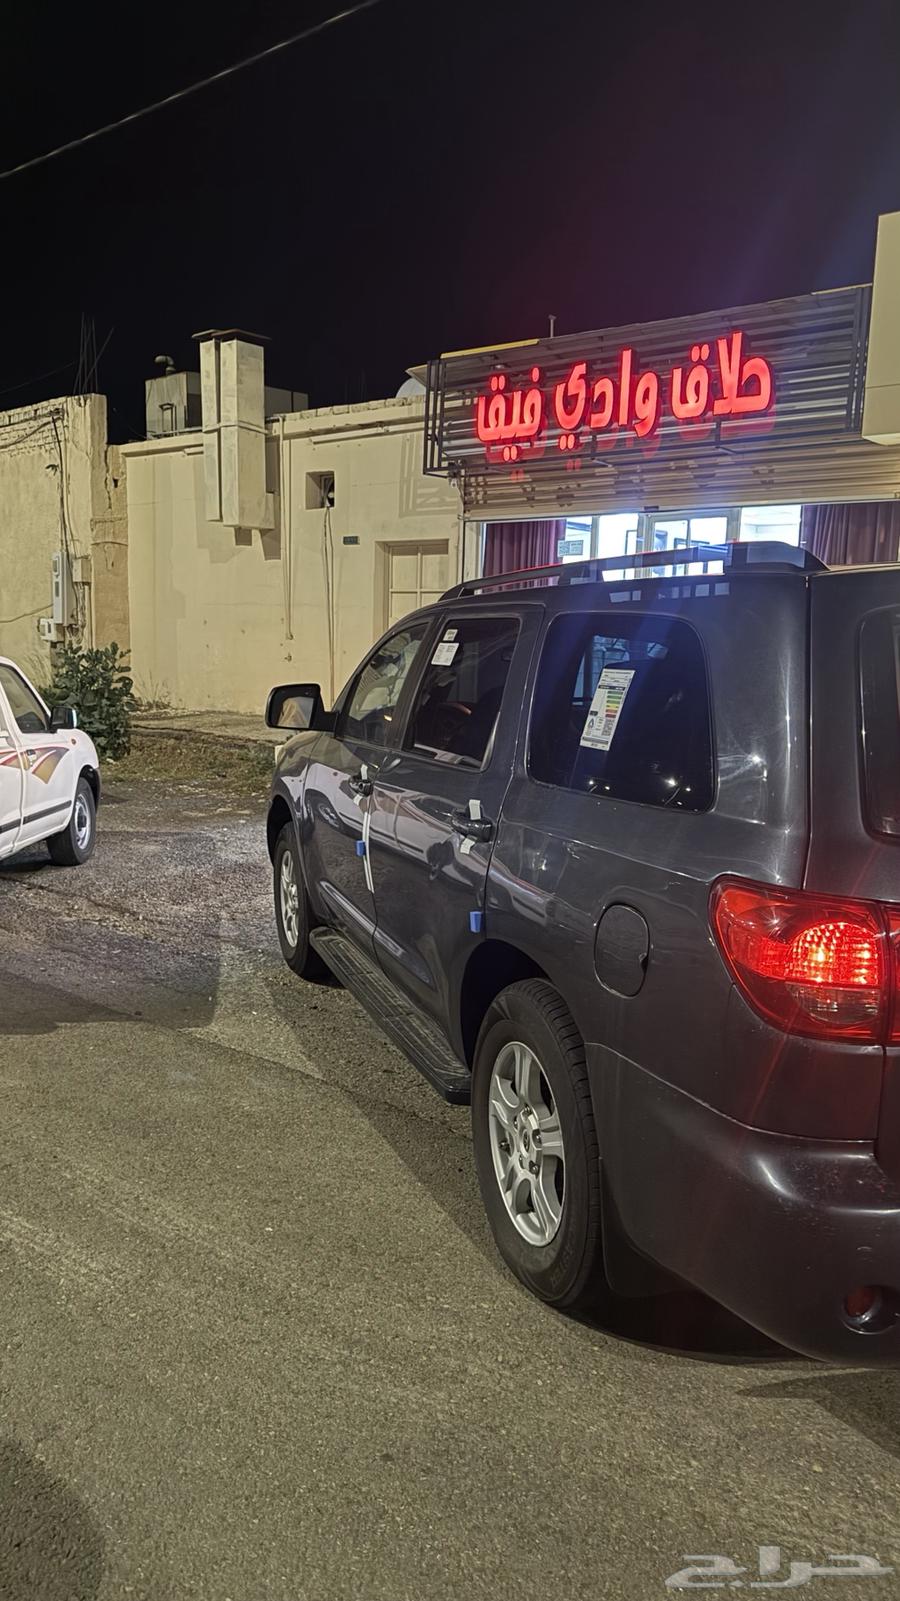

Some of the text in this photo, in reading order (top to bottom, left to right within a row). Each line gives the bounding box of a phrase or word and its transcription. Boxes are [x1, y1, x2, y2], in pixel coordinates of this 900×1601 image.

[476, 331, 773, 462] حلاق وادي فيق
